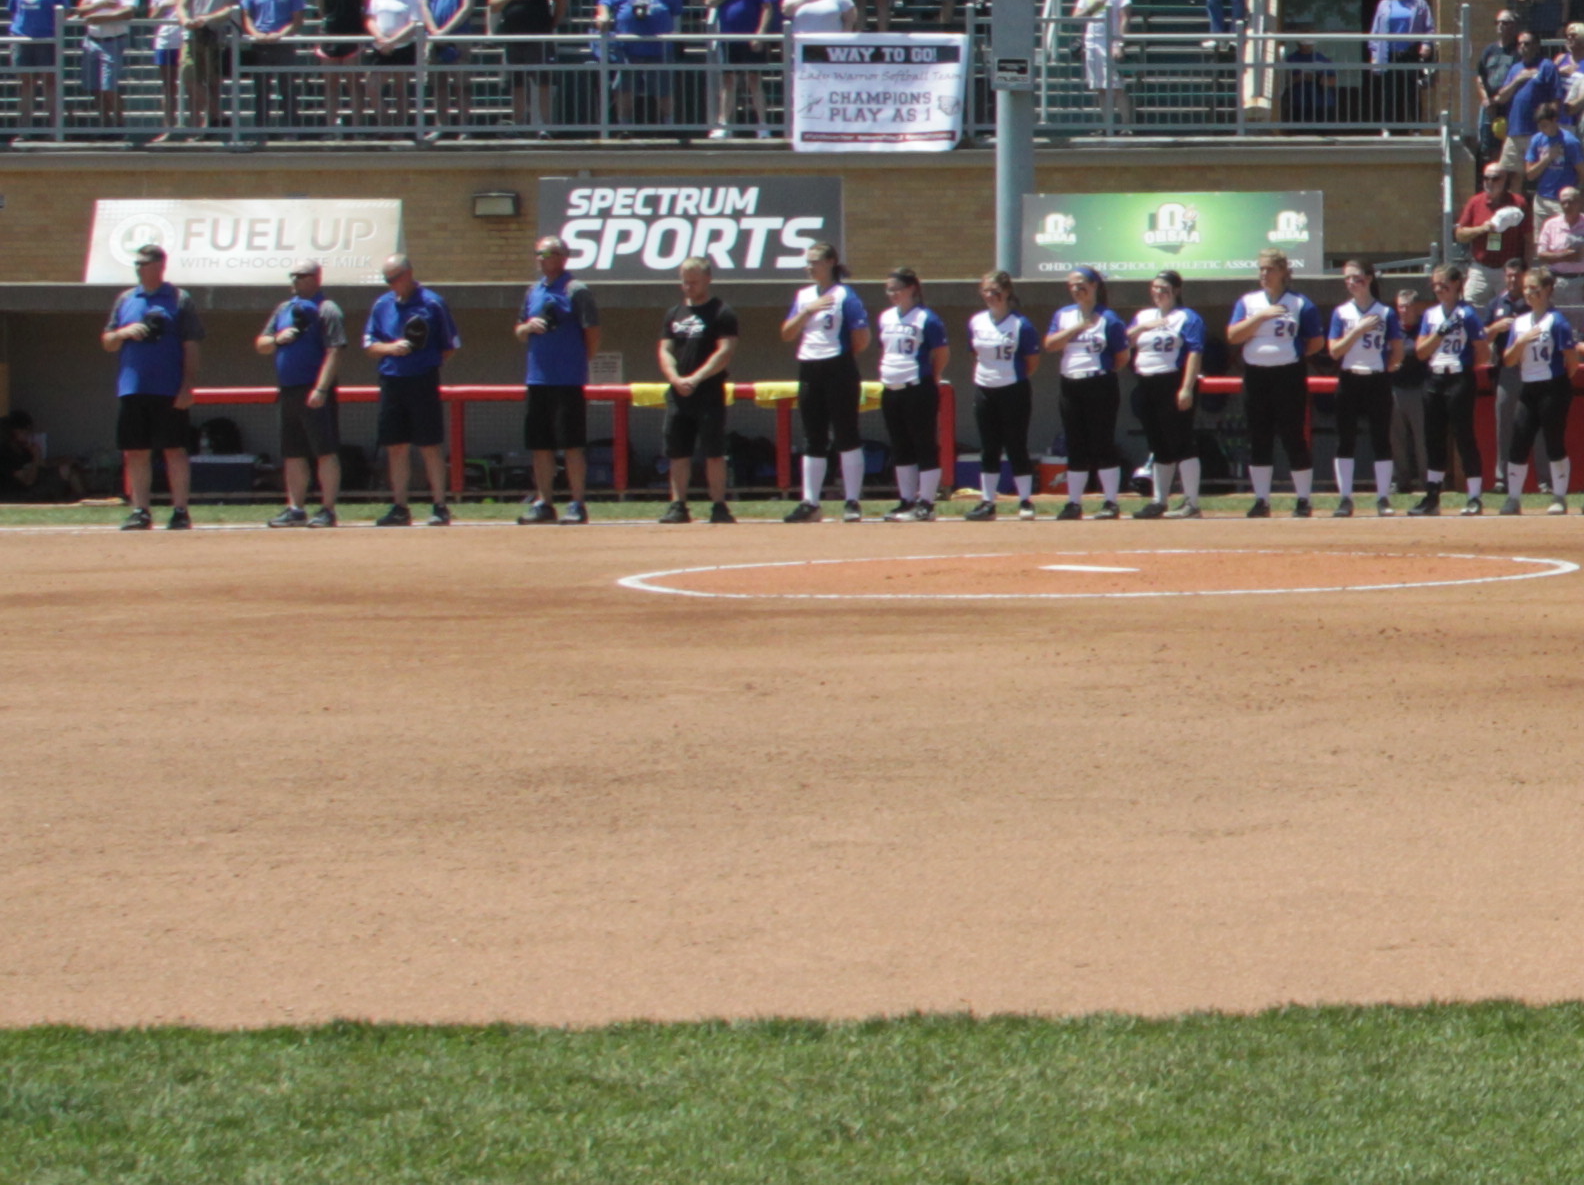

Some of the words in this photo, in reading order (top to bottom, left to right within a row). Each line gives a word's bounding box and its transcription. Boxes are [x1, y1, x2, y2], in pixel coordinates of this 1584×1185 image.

[827, 47, 875, 62] WAY
[881, 47, 905, 62] TO
[911, 47, 937, 62] GO!
[834, 71, 879, 81] Warrior
[881, 69, 928, 85] Softball
[933, 71, 963, 81] Team
[829, 91, 932, 105] CHAMPIONS
[829, 107, 883, 122] PLAY
[891, 107, 917, 122] AS
[925, 108, 931, 121] 1
[567, 187, 759, 216] SPECTRUM
[181, 218, 295, 251] FUEL
[311, 218, 377, 251] UP
[1144, 230, 1200, 244] OHSAA
[560, 217, 824, 270] SPORTS
[180, 256, 220, 269] WITH
[334, 256, 373, 269] MILK
[1039, 262, 1073, 272] OHIO
[1109, 261, 1156, 271] SCHOOL
[822, 314, 834, 330] 3
[896, 338, 915, 355] 13
[995, 346, 1012, 360] 15
[1153, 337, 1175, 353] 22
[1443, 338, 1461, 354] 20
[1532, 346, 1549, 362] 14
